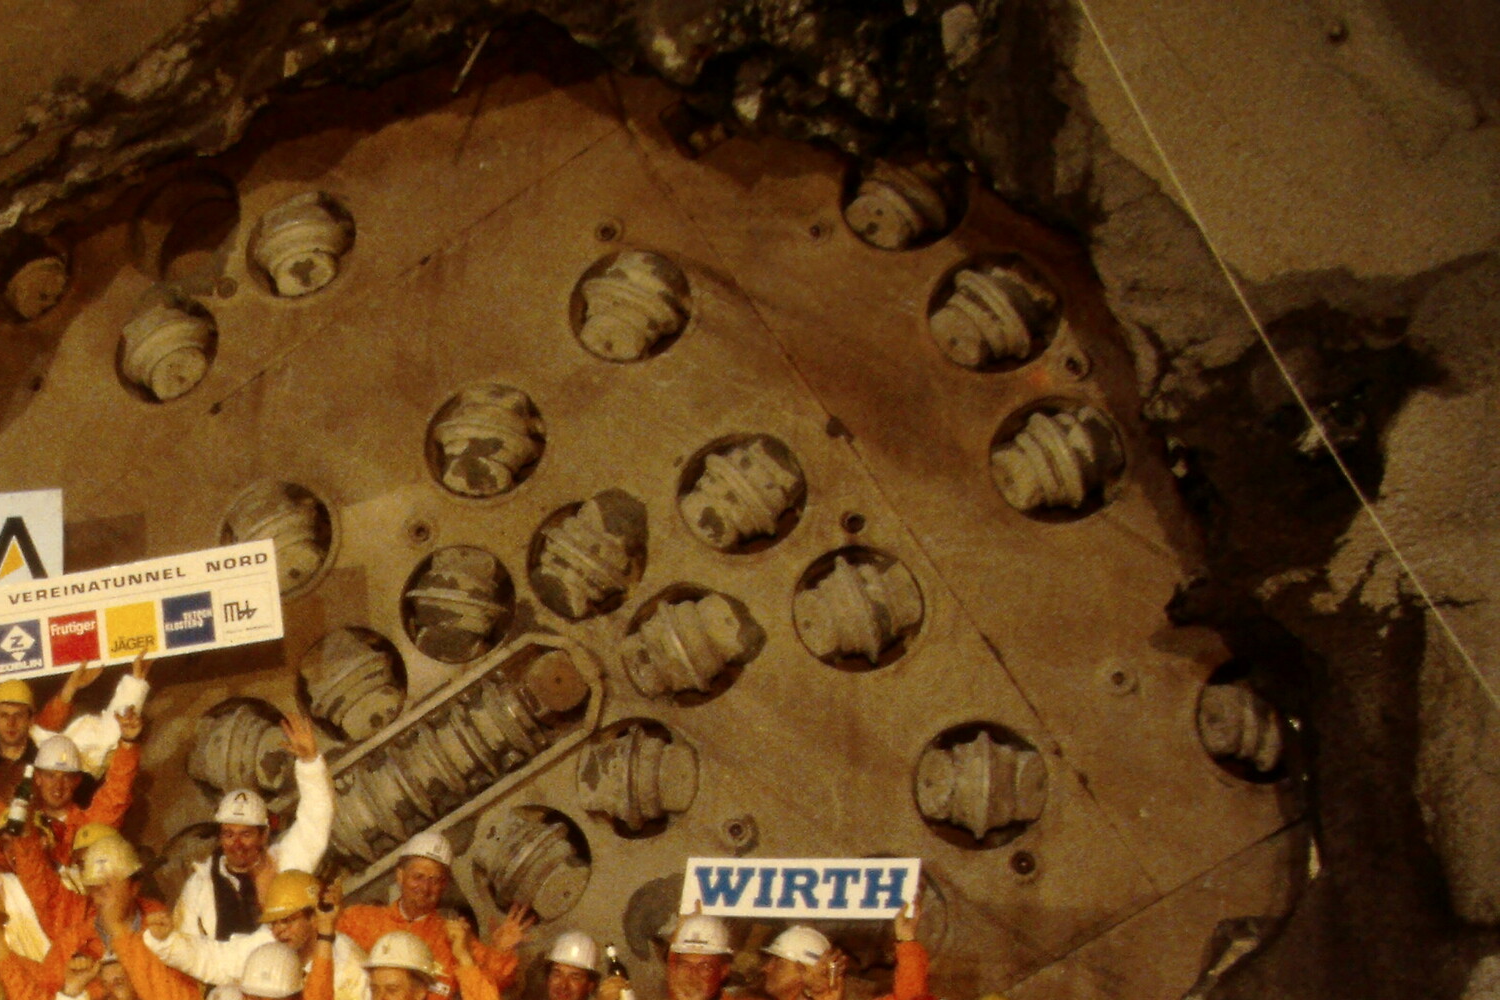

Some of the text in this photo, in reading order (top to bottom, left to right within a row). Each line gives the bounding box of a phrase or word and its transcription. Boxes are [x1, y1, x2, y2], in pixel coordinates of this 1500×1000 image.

[8, 567, 186, 606] VEREINATUNNEL
[206, 553, 268, 573] NORD
[50, 620, 96, 637] Frutiger
[111, 635, 156, 653] JÄGER
[695, 866, 908, 909] WIRTH
